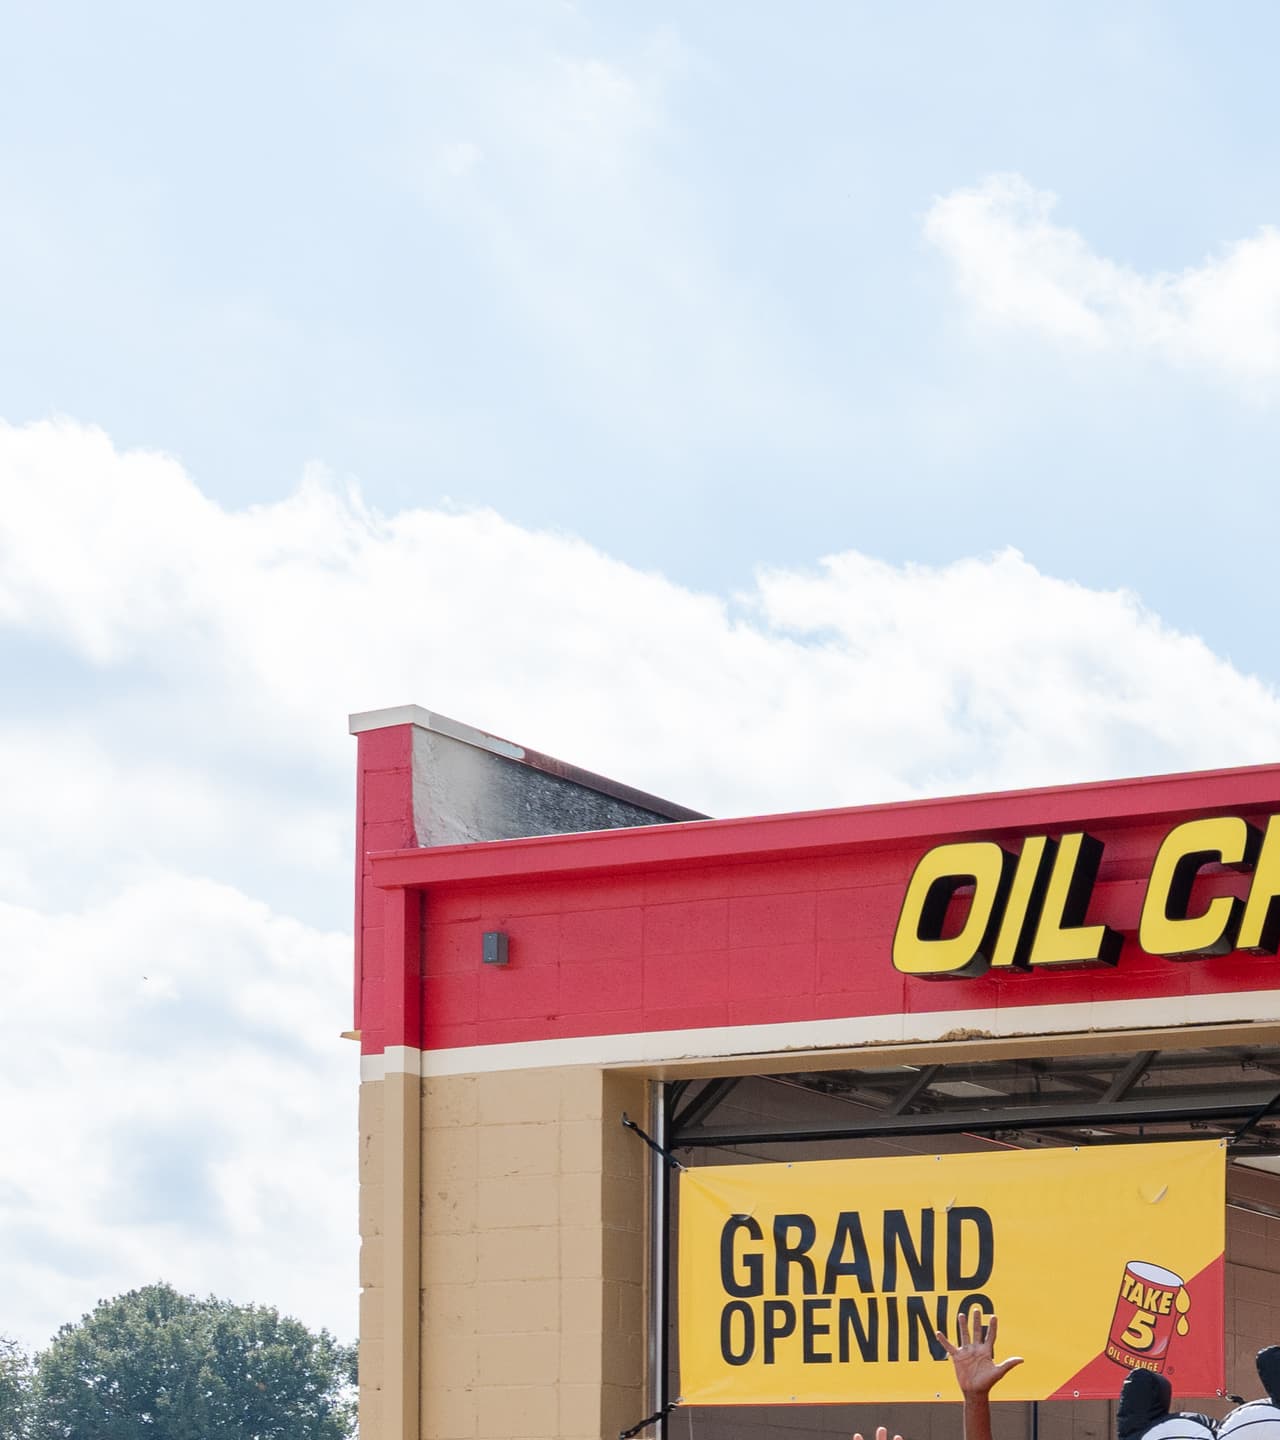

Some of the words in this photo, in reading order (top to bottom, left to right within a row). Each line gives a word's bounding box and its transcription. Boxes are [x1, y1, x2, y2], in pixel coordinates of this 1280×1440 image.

[892, 832, 1122, 980] OIL
[720, 1206, 994, 1298] GRAND
[1121, 1274, 1174, 1316] TAKE
[1120, 1309, 1156, 1352] 5
[1108, 1346, 1121, 1361] OIL
[1124, 1355, 1159, 1372] CHANGE
